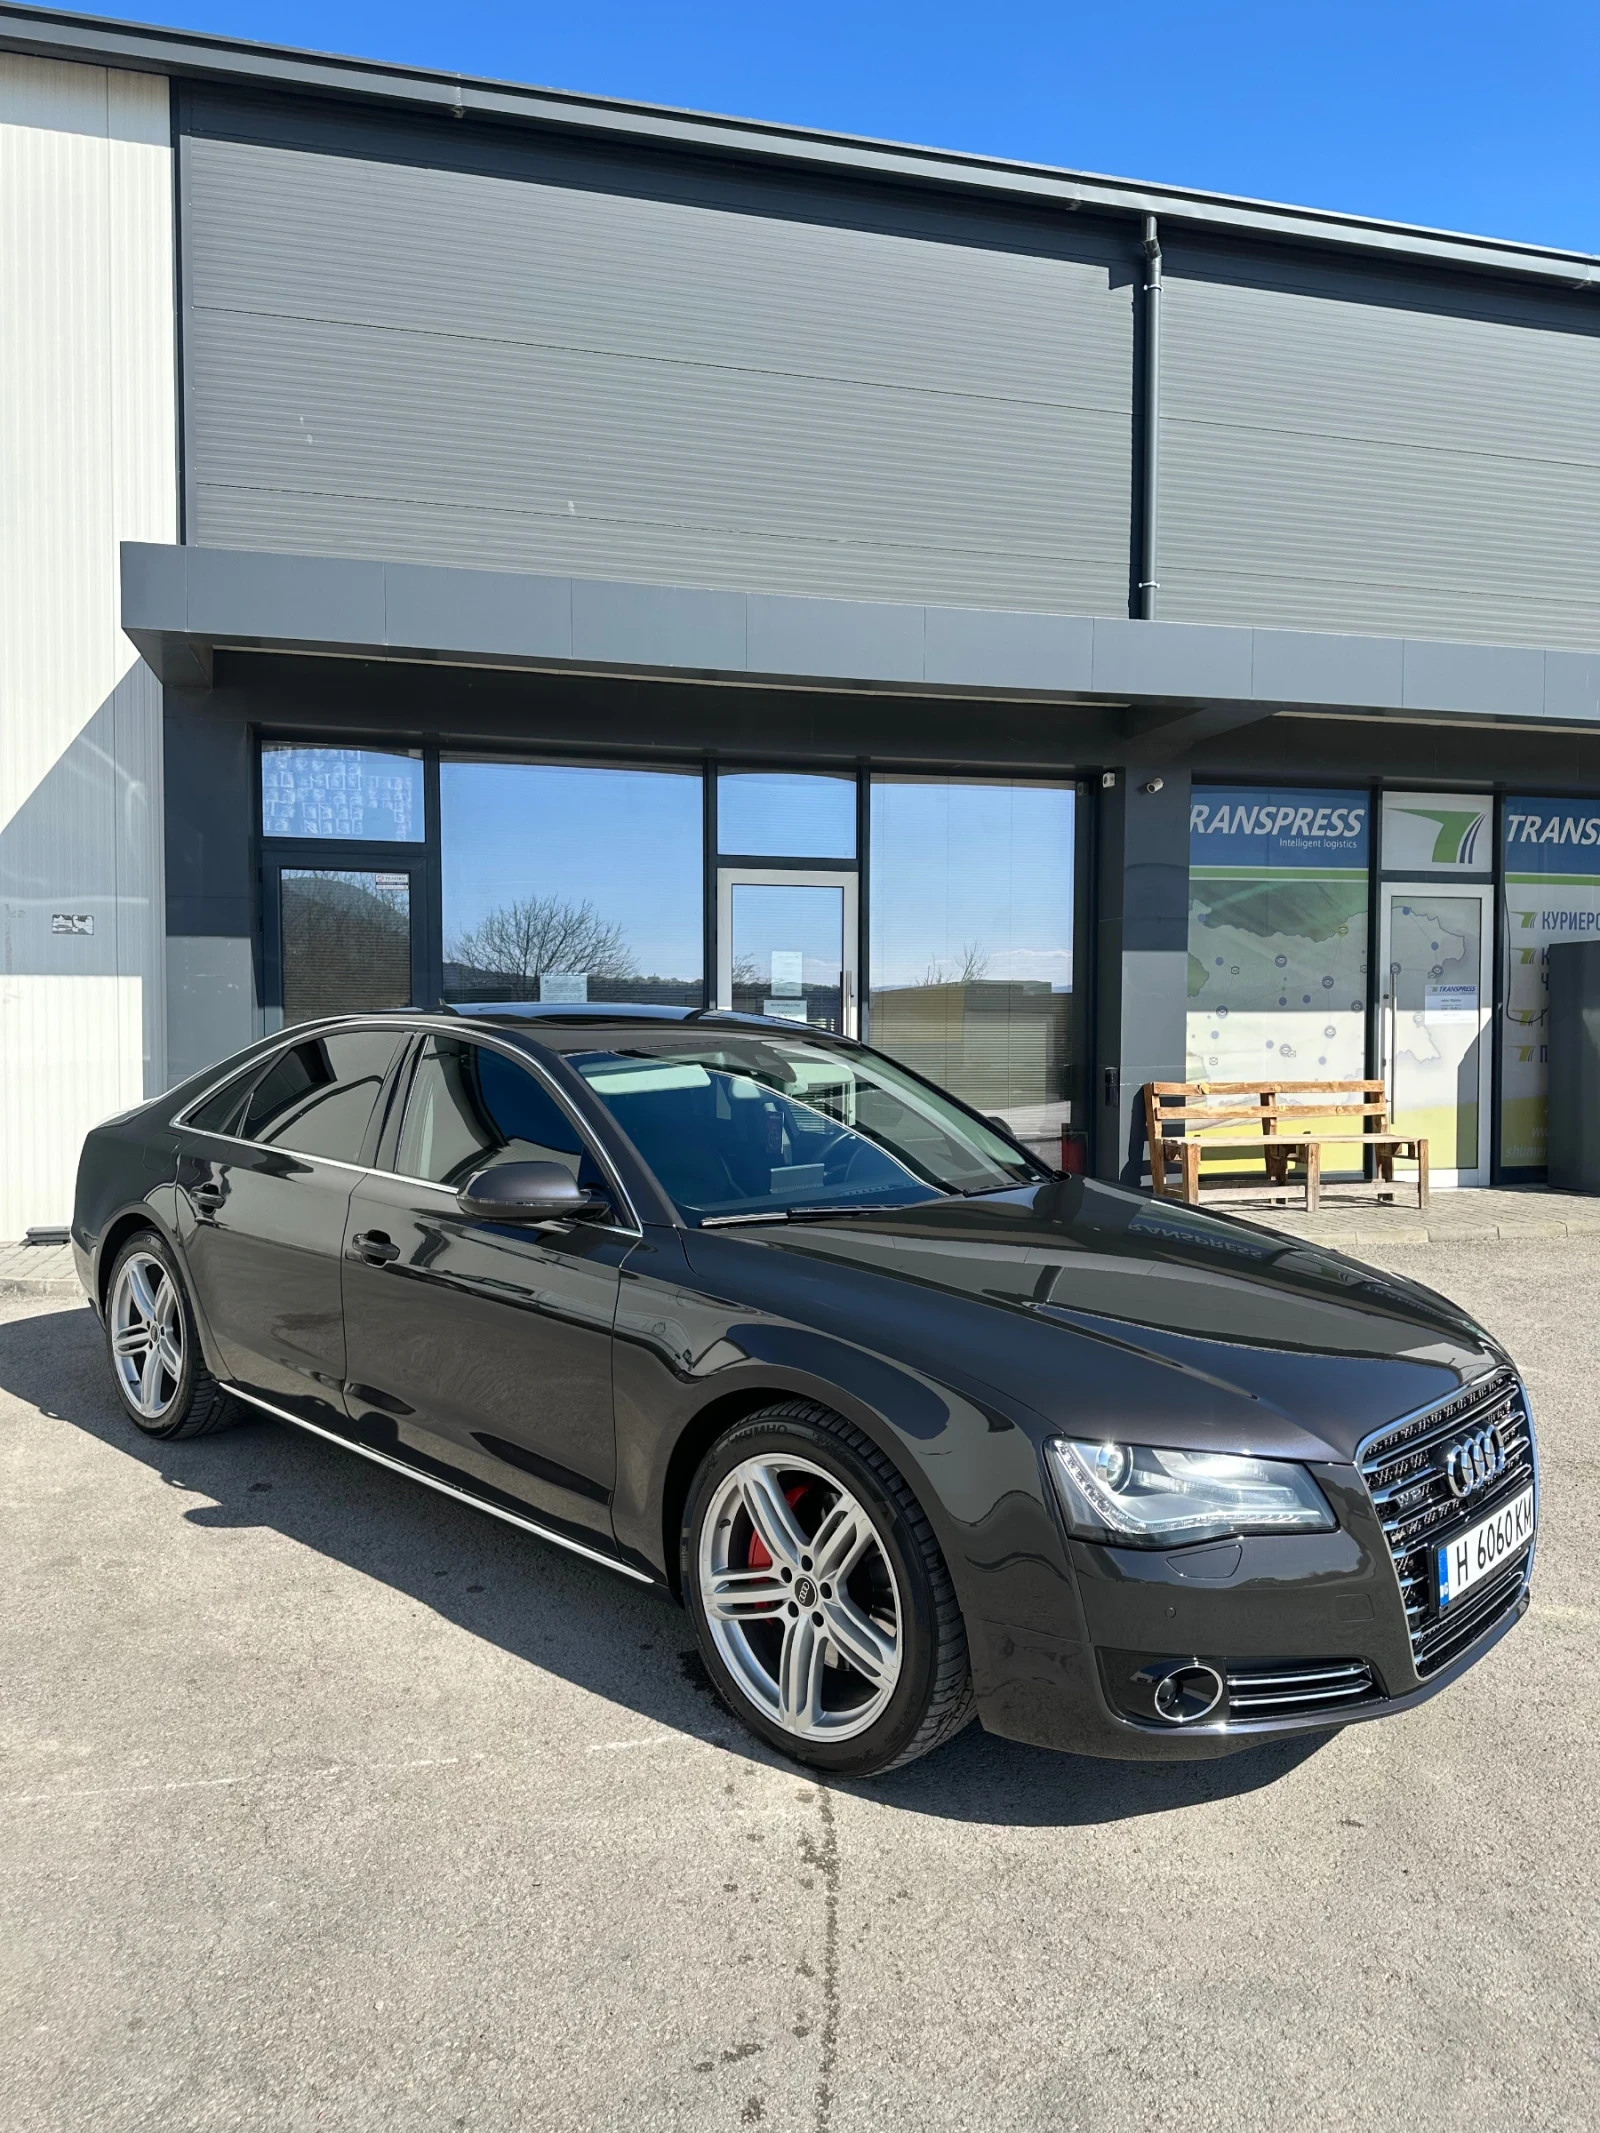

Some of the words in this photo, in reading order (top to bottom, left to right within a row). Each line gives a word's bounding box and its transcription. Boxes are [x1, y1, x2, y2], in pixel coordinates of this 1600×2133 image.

[1190, 804, 1366, 837] RANSPRESS
[1507, 815, 1600, 845] TRANS
[1279, 838, 1321, 849] Intelligent
[1323, 839, 1358, 850] logistics
[1456, 1541, 1468, 1586] H
[1477, 1509, 1513, 1570] 6060
